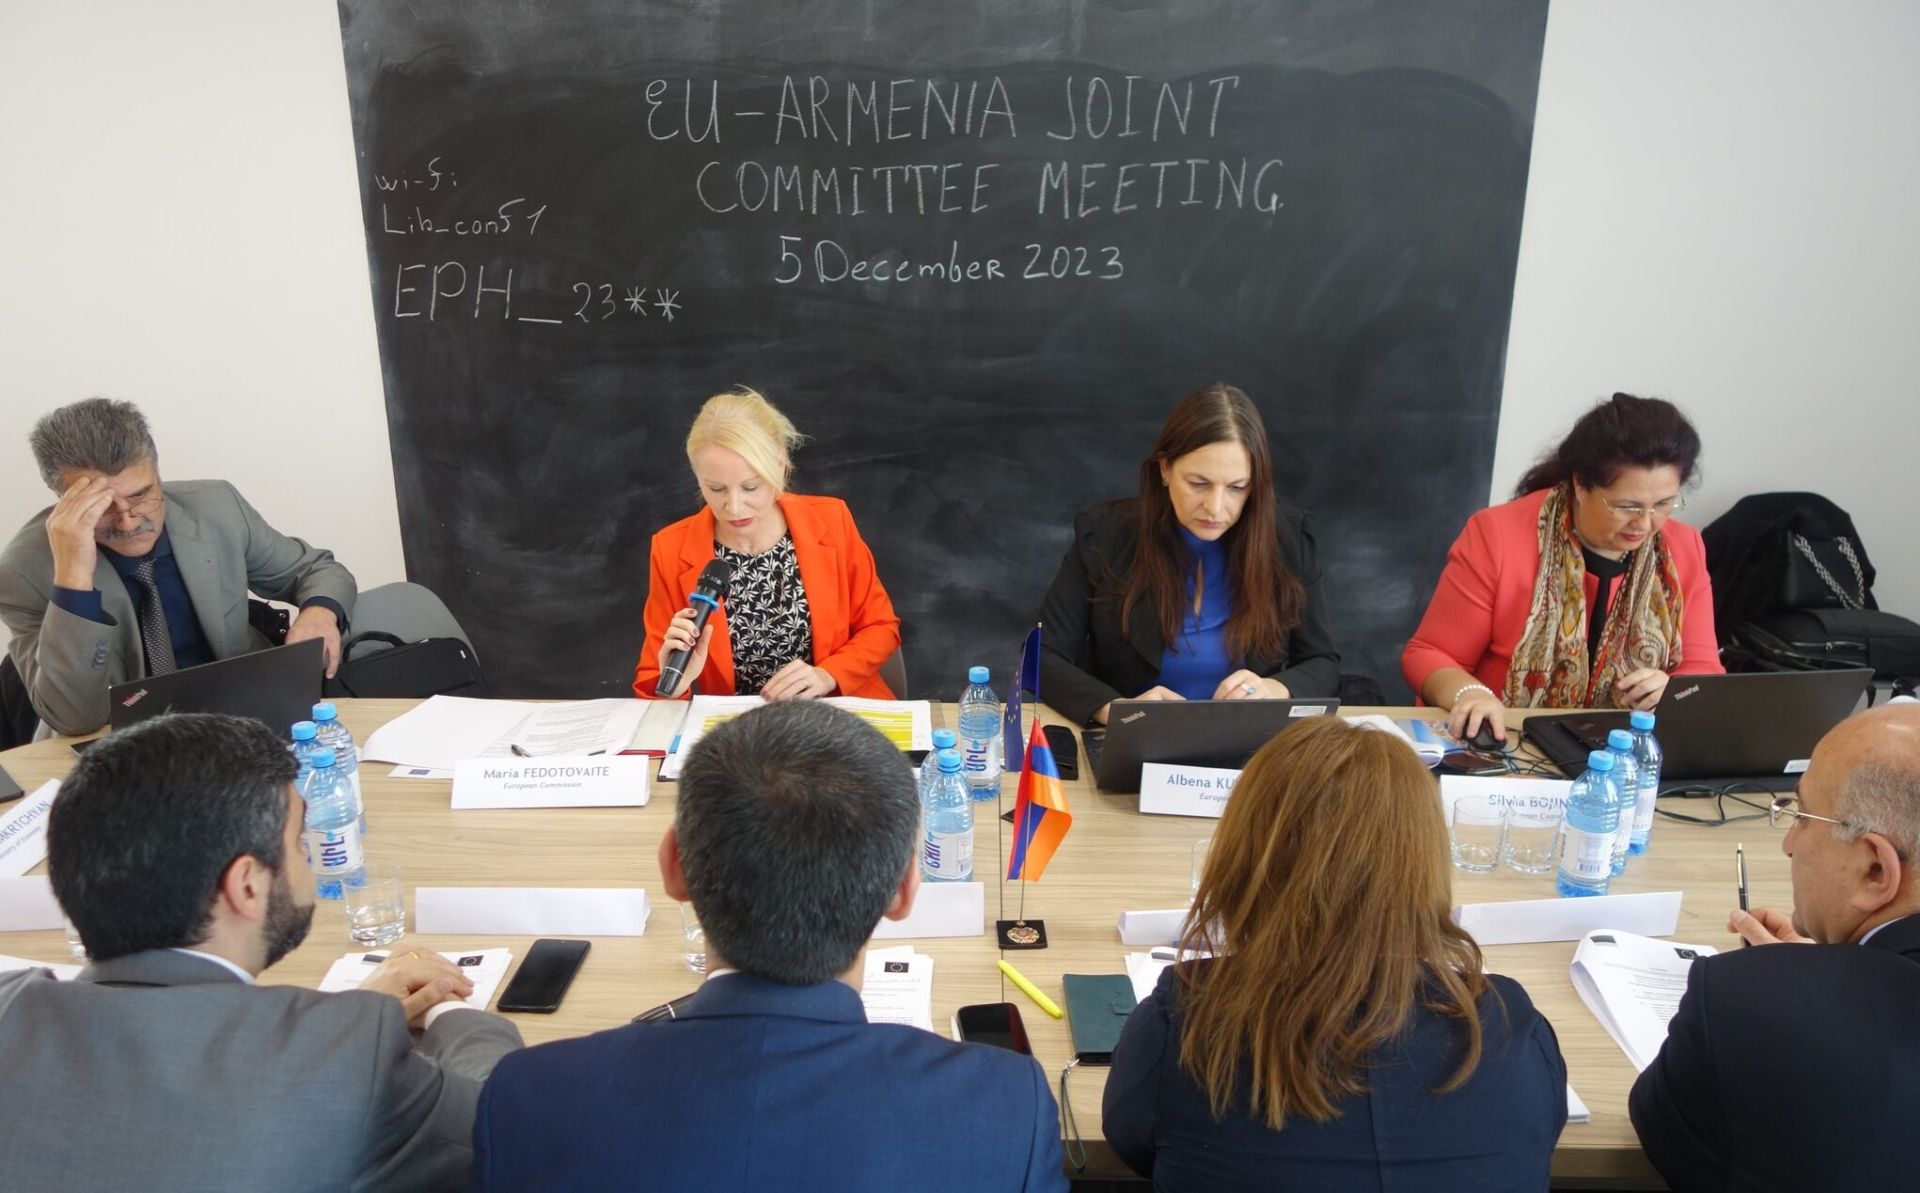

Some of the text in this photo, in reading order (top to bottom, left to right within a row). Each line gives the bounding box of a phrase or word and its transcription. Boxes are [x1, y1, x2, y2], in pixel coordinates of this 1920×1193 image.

[1047, 75, 1239, 140] JOINT
[697, 157, 1284, 219] COMMITTEE MEETING
[775, 235, 802, 283] 5
[1023, 243, 1124, 280] 2023
[483, 766, 610, 779] Maria FEDOTOVAITE
[1167, 774, 1238, 790] Albena KU
